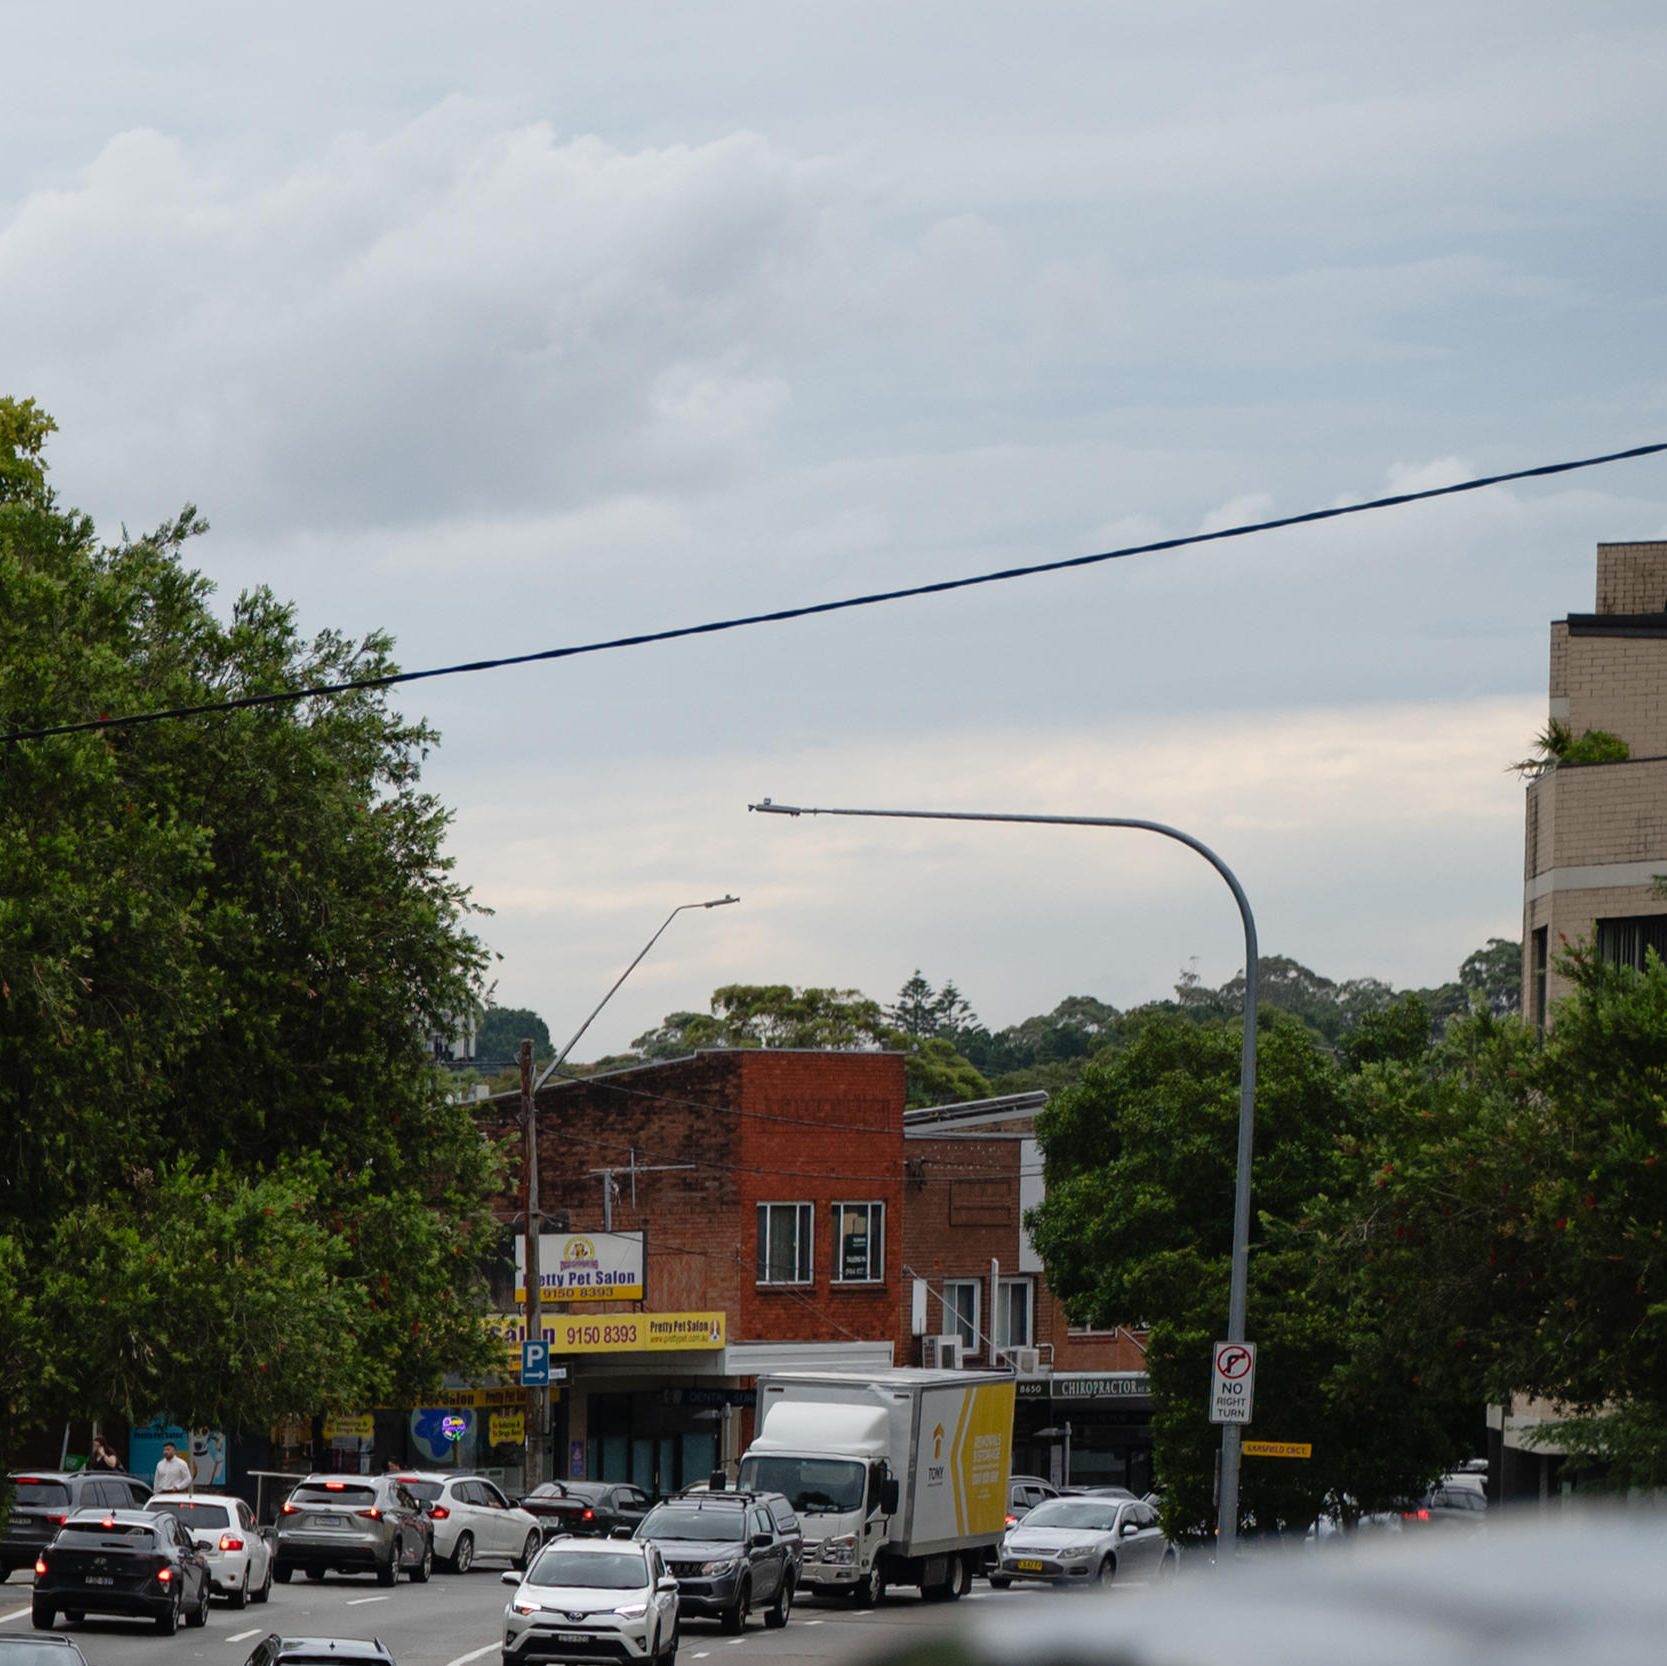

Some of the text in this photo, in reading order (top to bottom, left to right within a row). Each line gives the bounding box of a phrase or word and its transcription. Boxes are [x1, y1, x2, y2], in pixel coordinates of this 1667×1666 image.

[569, 1272, 590, 1286] Pet
[595, 1270, 636, 1285] Salon
[543, 1287, 614, 1298] 9150 8393
[650, 1319, 709, 1334] Pretty Pet Salon
[567, 1327, 600, 1345] 9150
[603, 1325, 637, 1344] 8393
[527, 1345, 544, 1368] P
[1061, 1381, 1137, 1395] CHIROPRACTOR
[1222, 1382, 1243, 1395] NO
[1217, 1397, 1246, 1406] RIGHT
[1218, 1409, 1245, 1417] TURN
